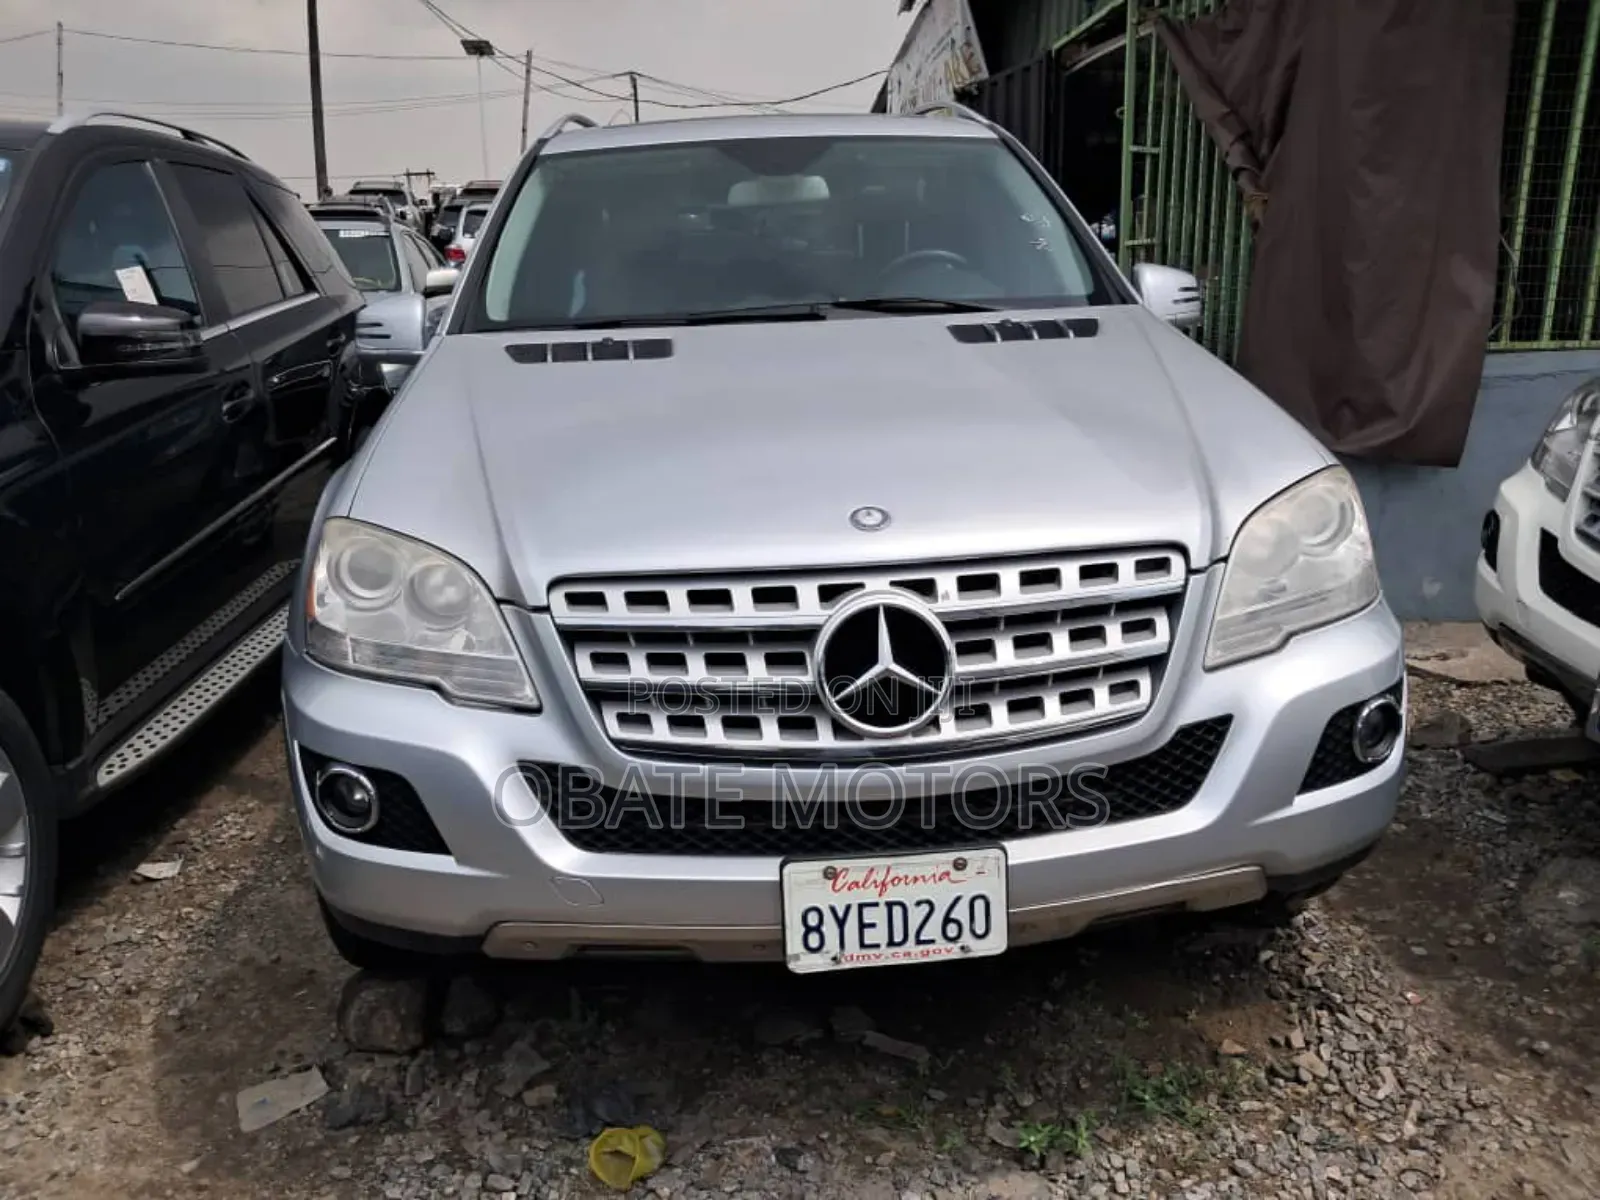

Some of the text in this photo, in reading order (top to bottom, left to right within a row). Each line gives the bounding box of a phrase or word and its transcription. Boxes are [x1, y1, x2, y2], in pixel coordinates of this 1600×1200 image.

[831, 866, 966, 897] California
[801, 893, 991, 953] 8YED260
[842, 945, 954, 964] dmv.ca.gov
